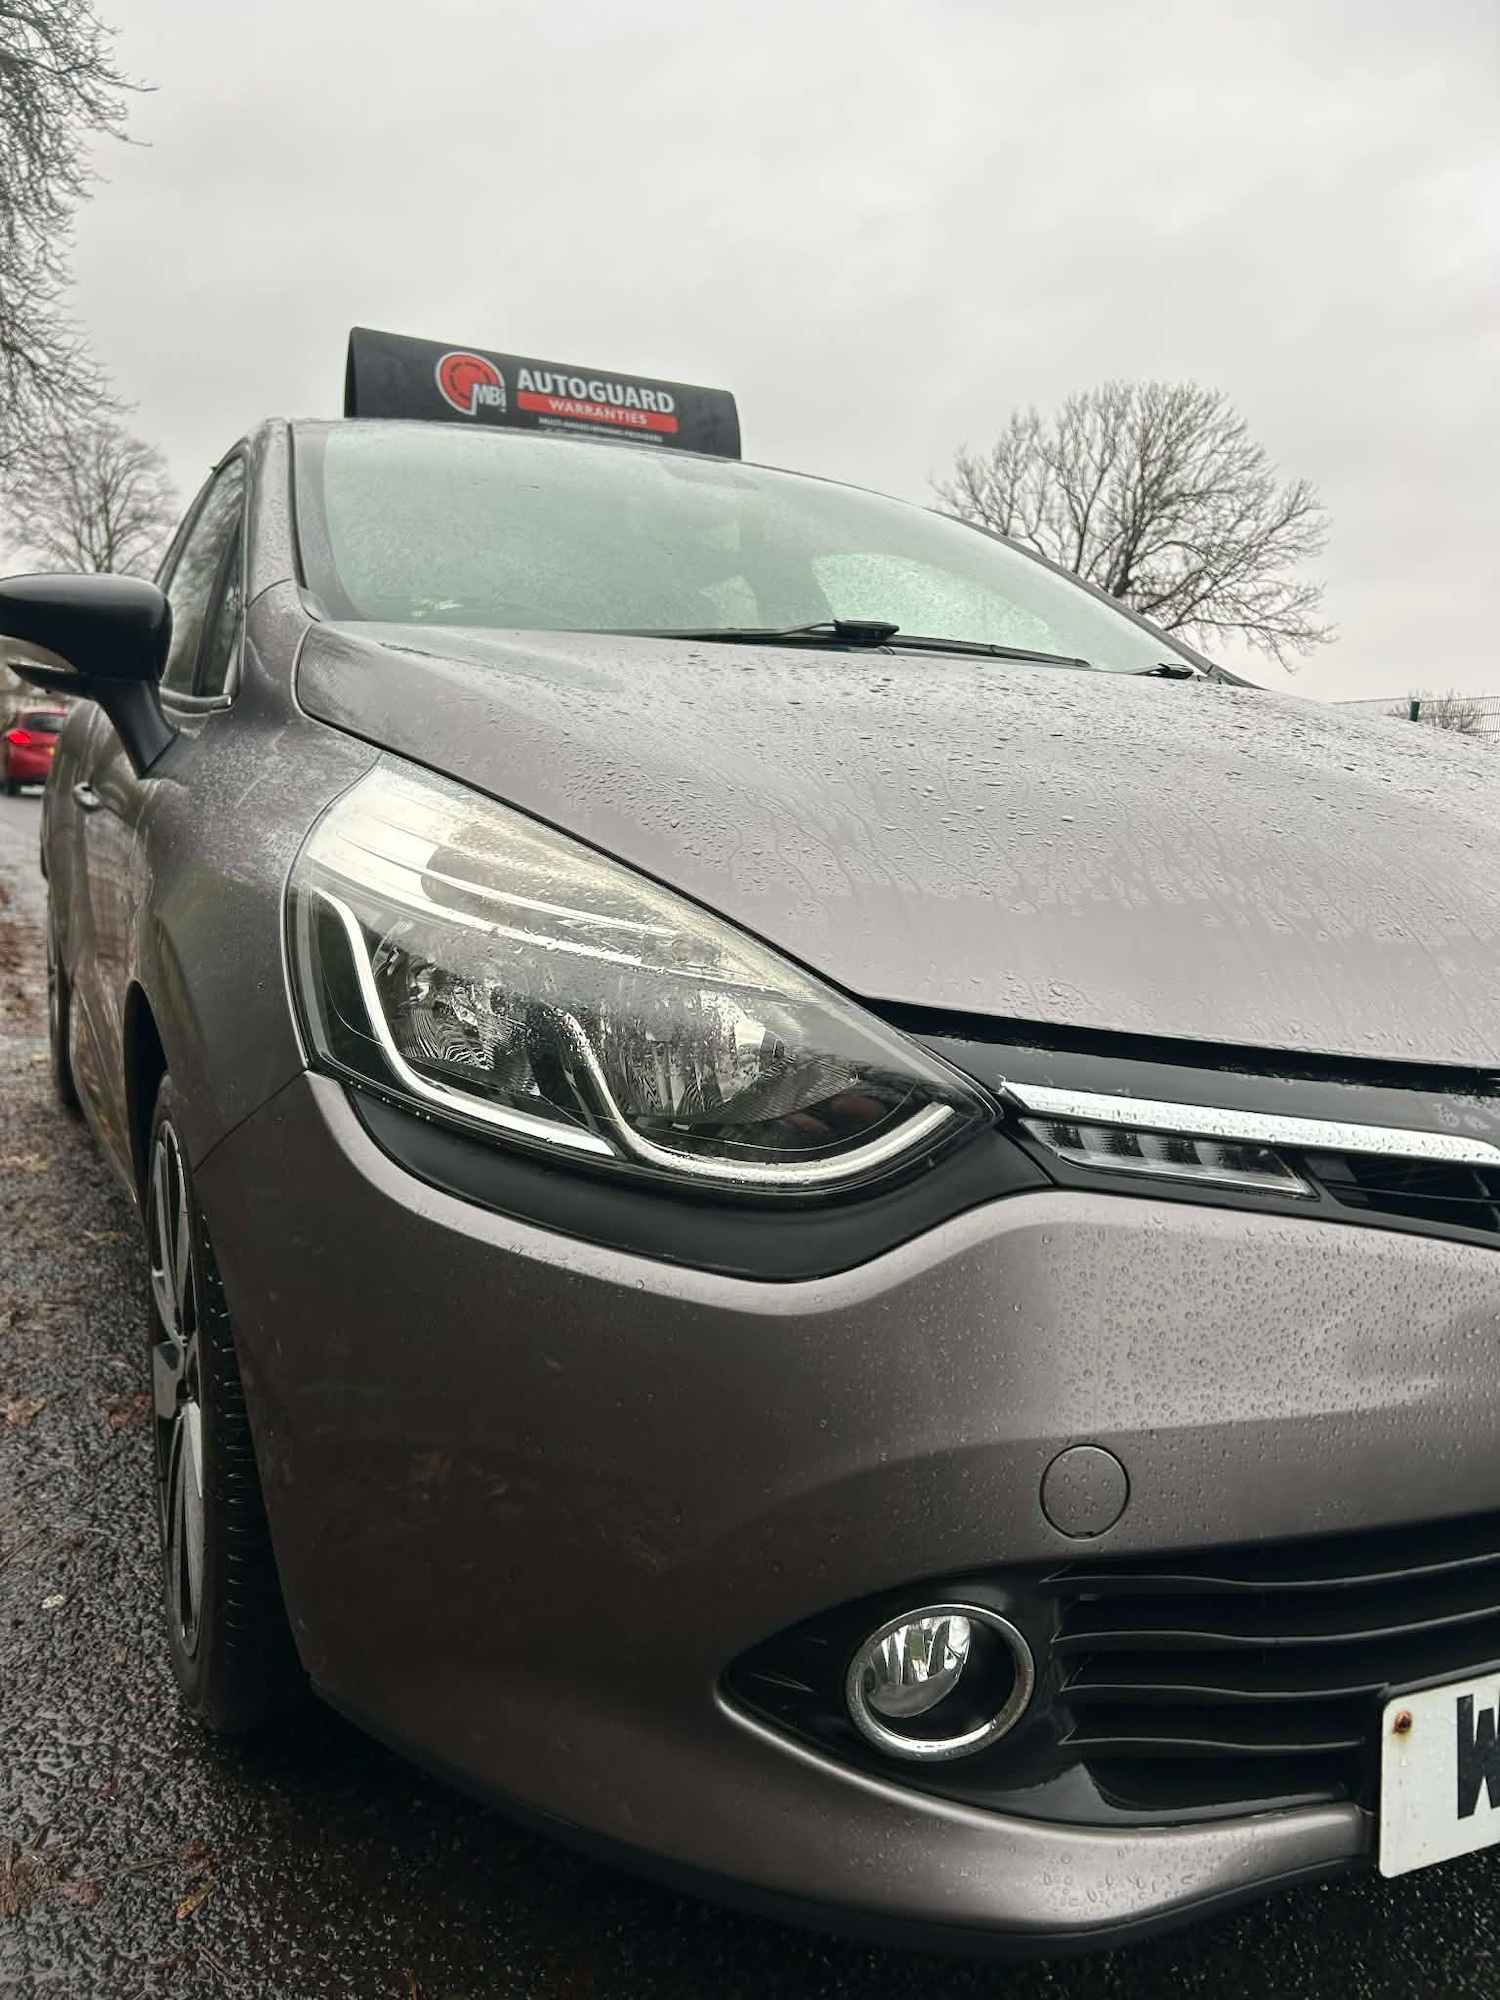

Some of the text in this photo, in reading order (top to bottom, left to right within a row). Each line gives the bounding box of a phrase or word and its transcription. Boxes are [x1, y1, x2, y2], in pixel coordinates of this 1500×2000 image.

[516, 368, 675, 413] AUTOGUARD
[548, 399, 649, 425] WARRANTIES
[1457, 1687, 1500, 1820] W
